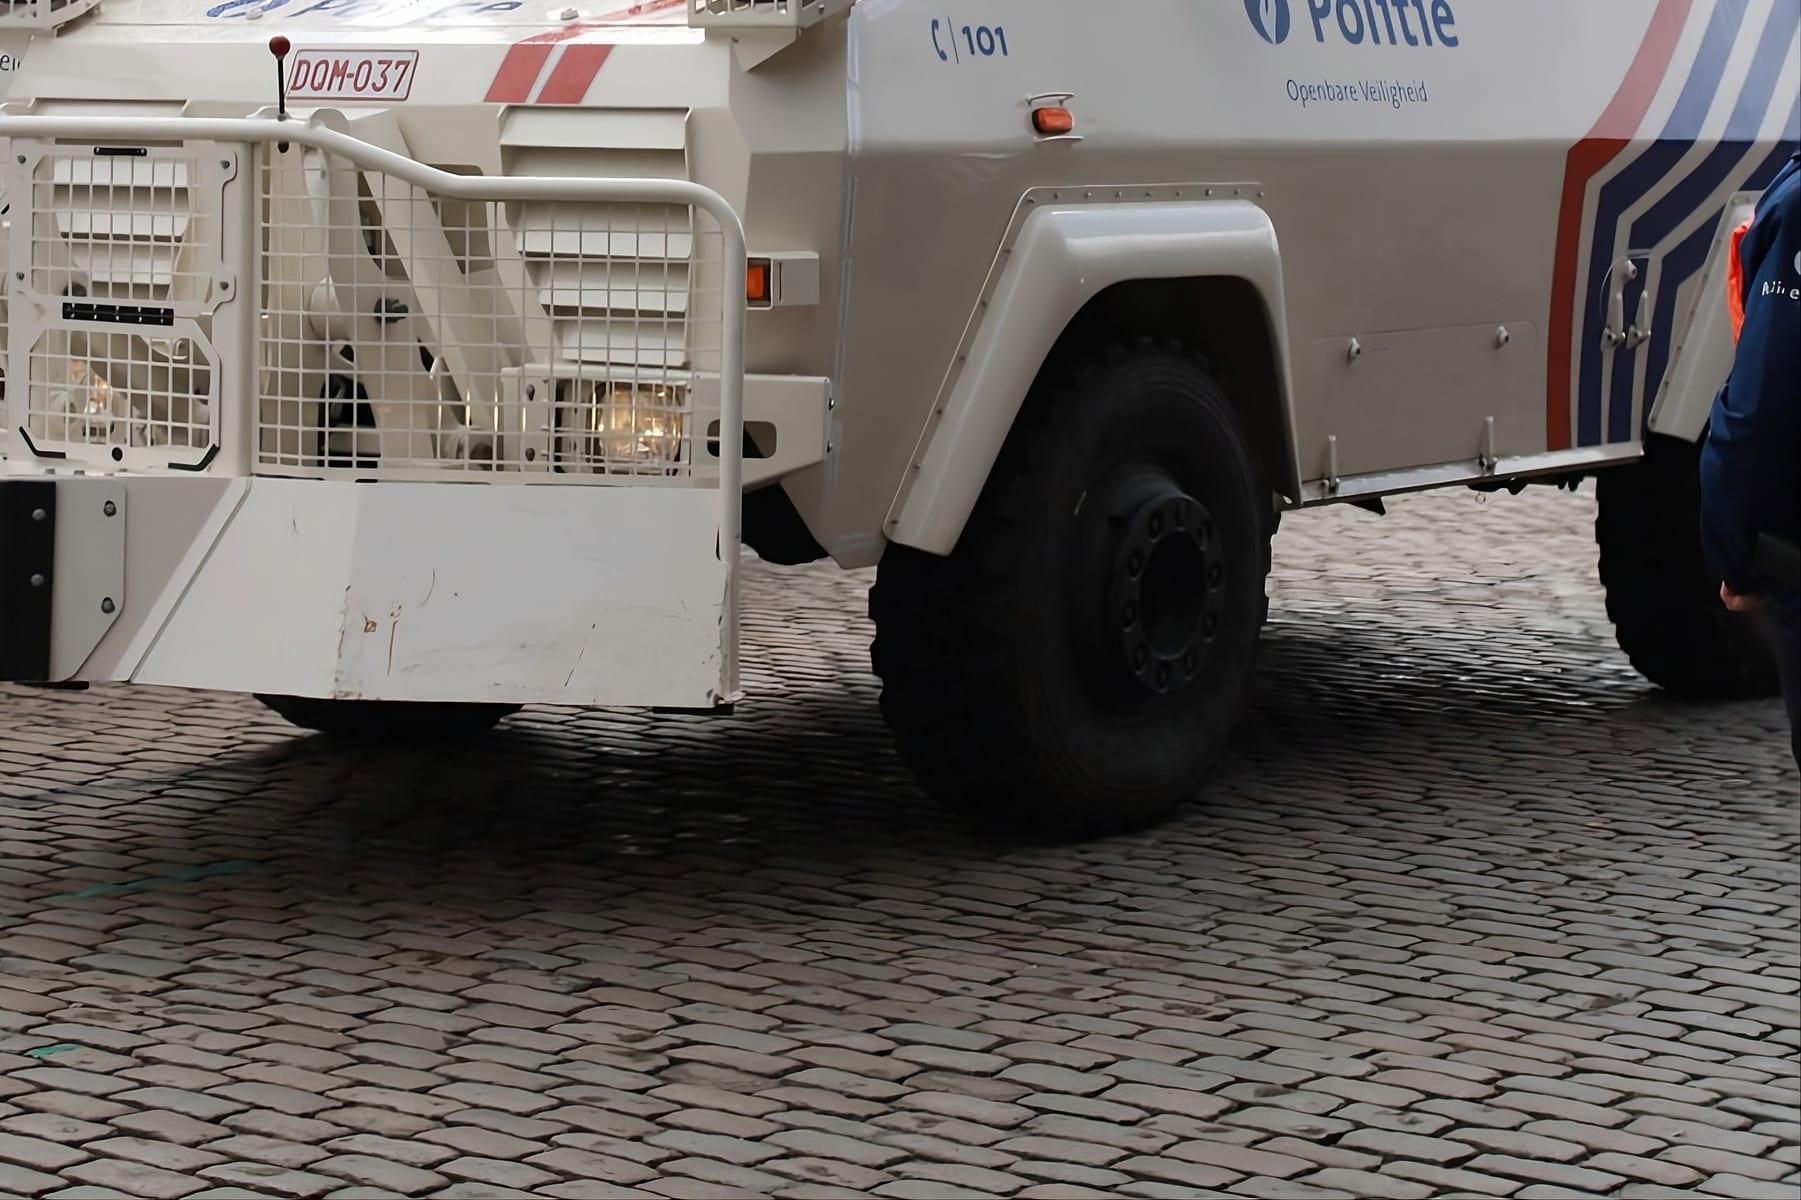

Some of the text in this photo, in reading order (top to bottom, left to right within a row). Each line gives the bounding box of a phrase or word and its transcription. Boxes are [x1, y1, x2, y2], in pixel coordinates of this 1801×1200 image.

[962, 26, 1008, 56] 101
[1286, 79, 1427, 109] Openbare Veiligheid
